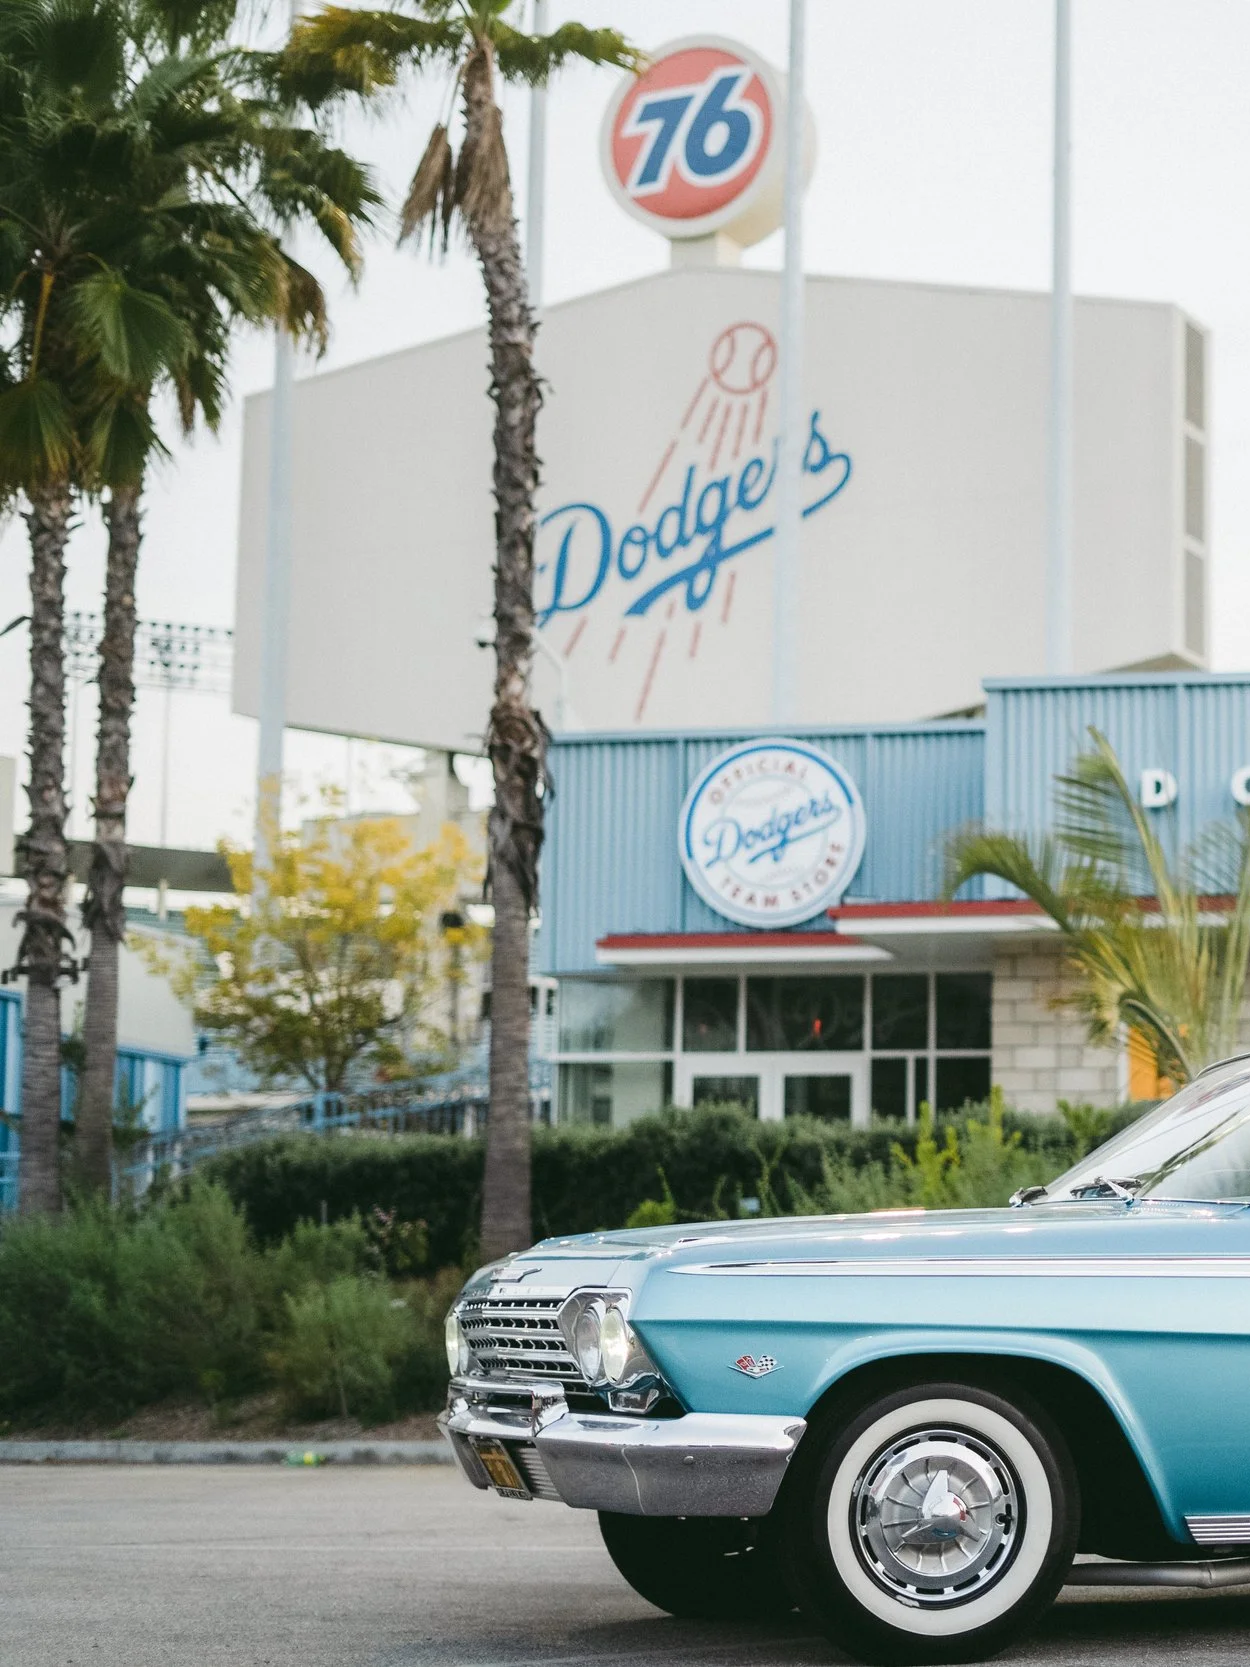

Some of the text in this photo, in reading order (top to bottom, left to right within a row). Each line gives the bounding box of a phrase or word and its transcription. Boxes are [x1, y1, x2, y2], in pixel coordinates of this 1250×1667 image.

[634, 71, 754, 189] 76
[709, 760, 807, 803] OFFICIAL
[703, 789, 842, 868] Dodgers
[722, 844, 843, 907] TEAM STORE
